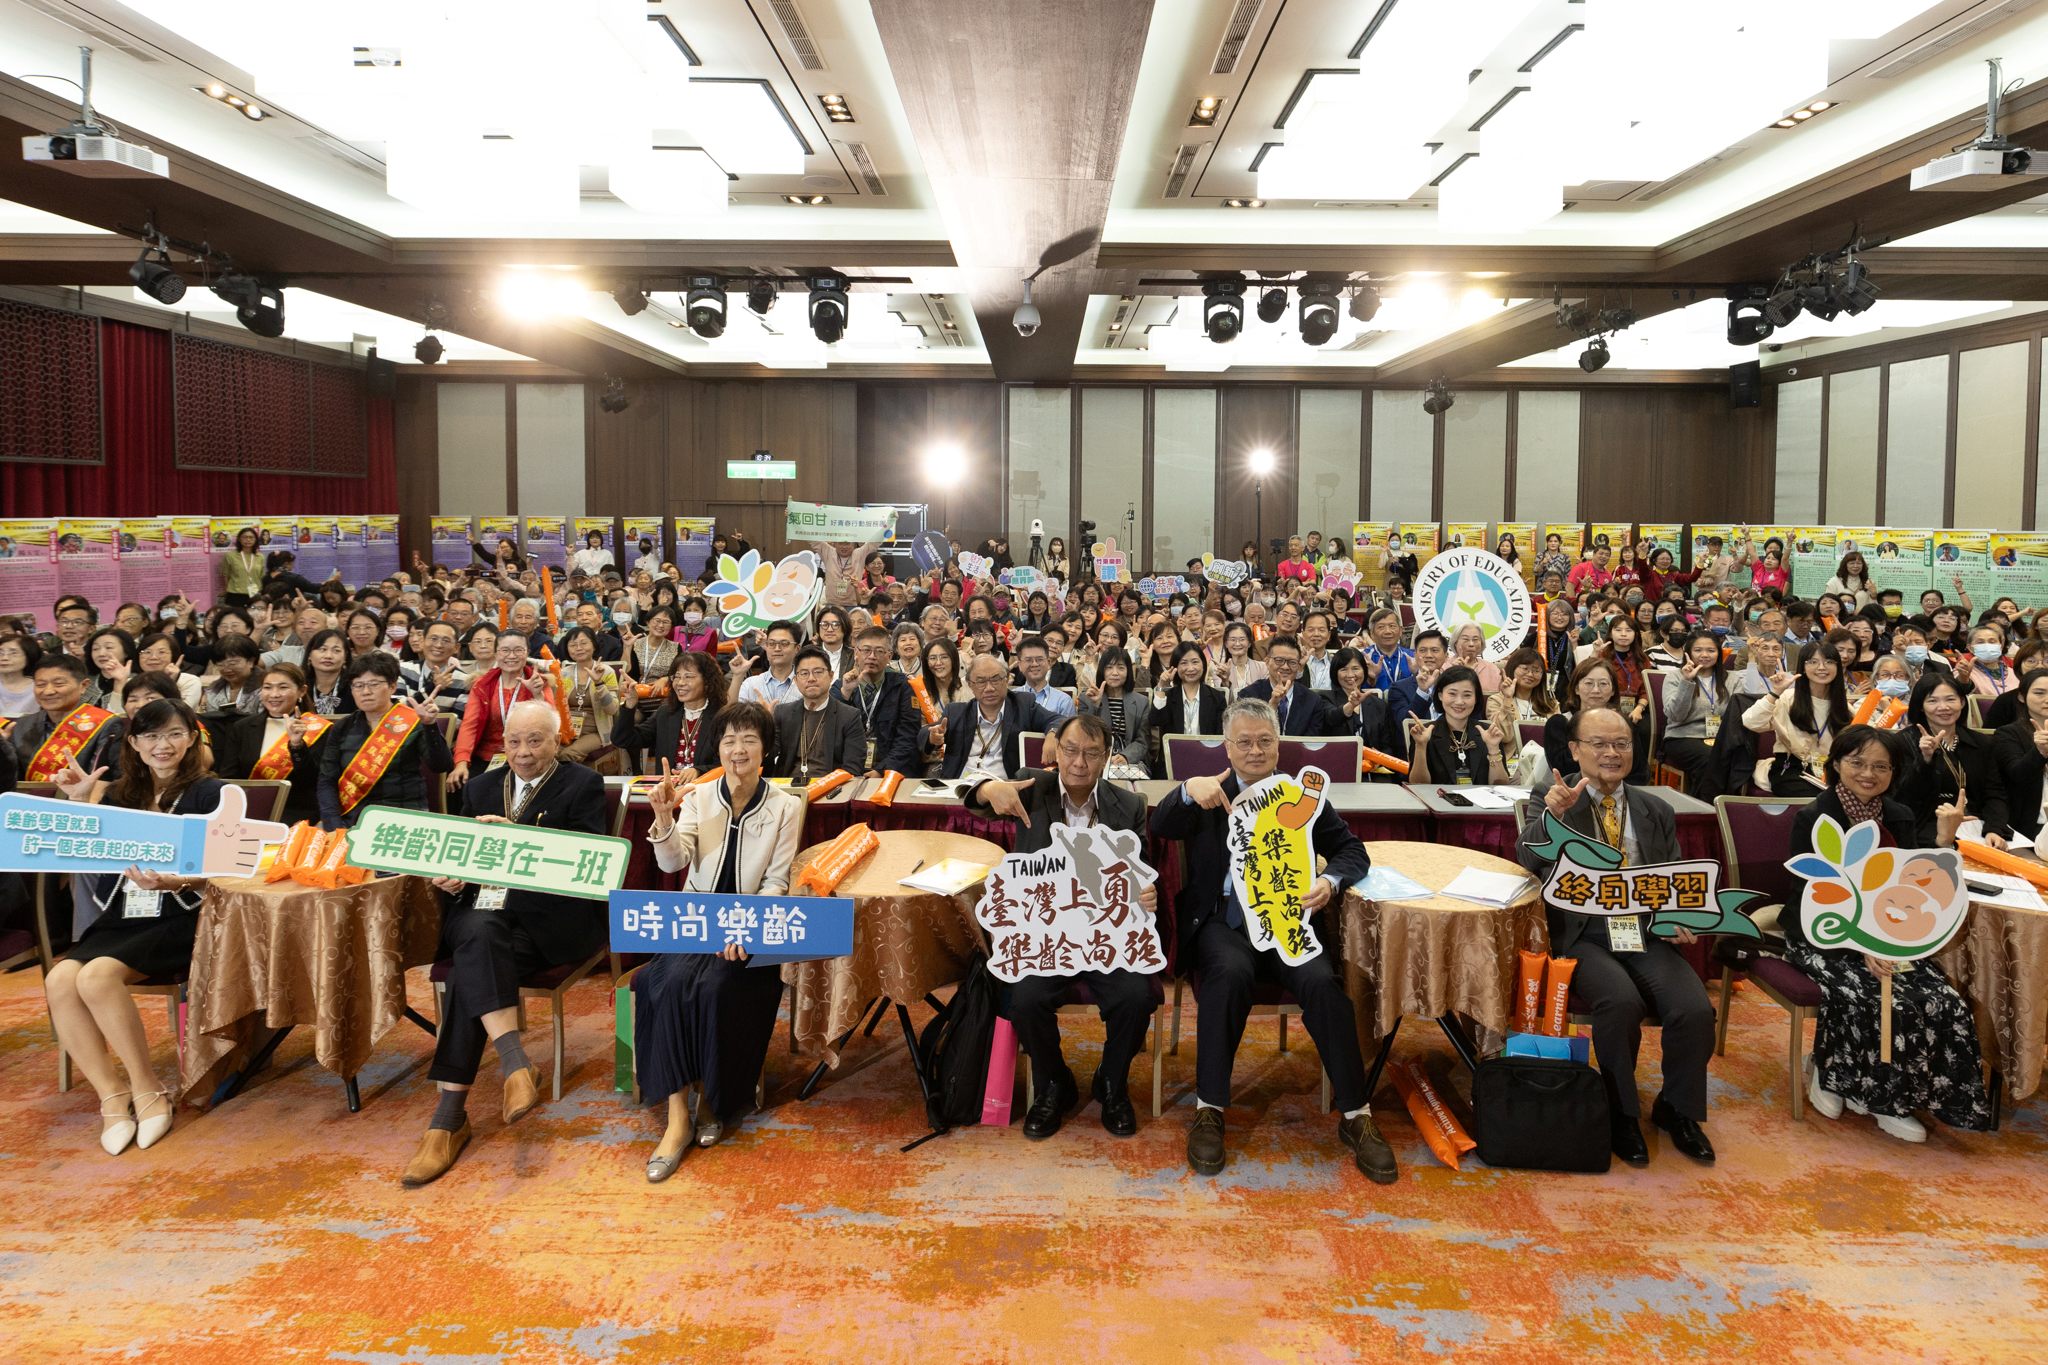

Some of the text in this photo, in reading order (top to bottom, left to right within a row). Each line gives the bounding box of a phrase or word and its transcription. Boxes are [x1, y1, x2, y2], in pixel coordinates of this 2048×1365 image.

[1448, 554, 1469, 568] OF
[1474, 555, 1524, 635] EDUCATION
[5, 810, 100, 833] 樂齡學習就是
[1236, 784, 1285, 818] TAIWAN
[22, 835, 175, 862] 許一個老得起的未來
[369, 823, 613, 886] 樂齡同學在一班
[1007, 854, 1066, 878] TAIWAN
[981, 860, 1130, 929] 臺灣上勇
[1552, 870, 1709, 910] 終身學習
[623, 901, 808, 945] 時尚樂齡
[993, 927, 1162, 977] 樂齡尚強
[1553, 982, 1569, 1036] earning
